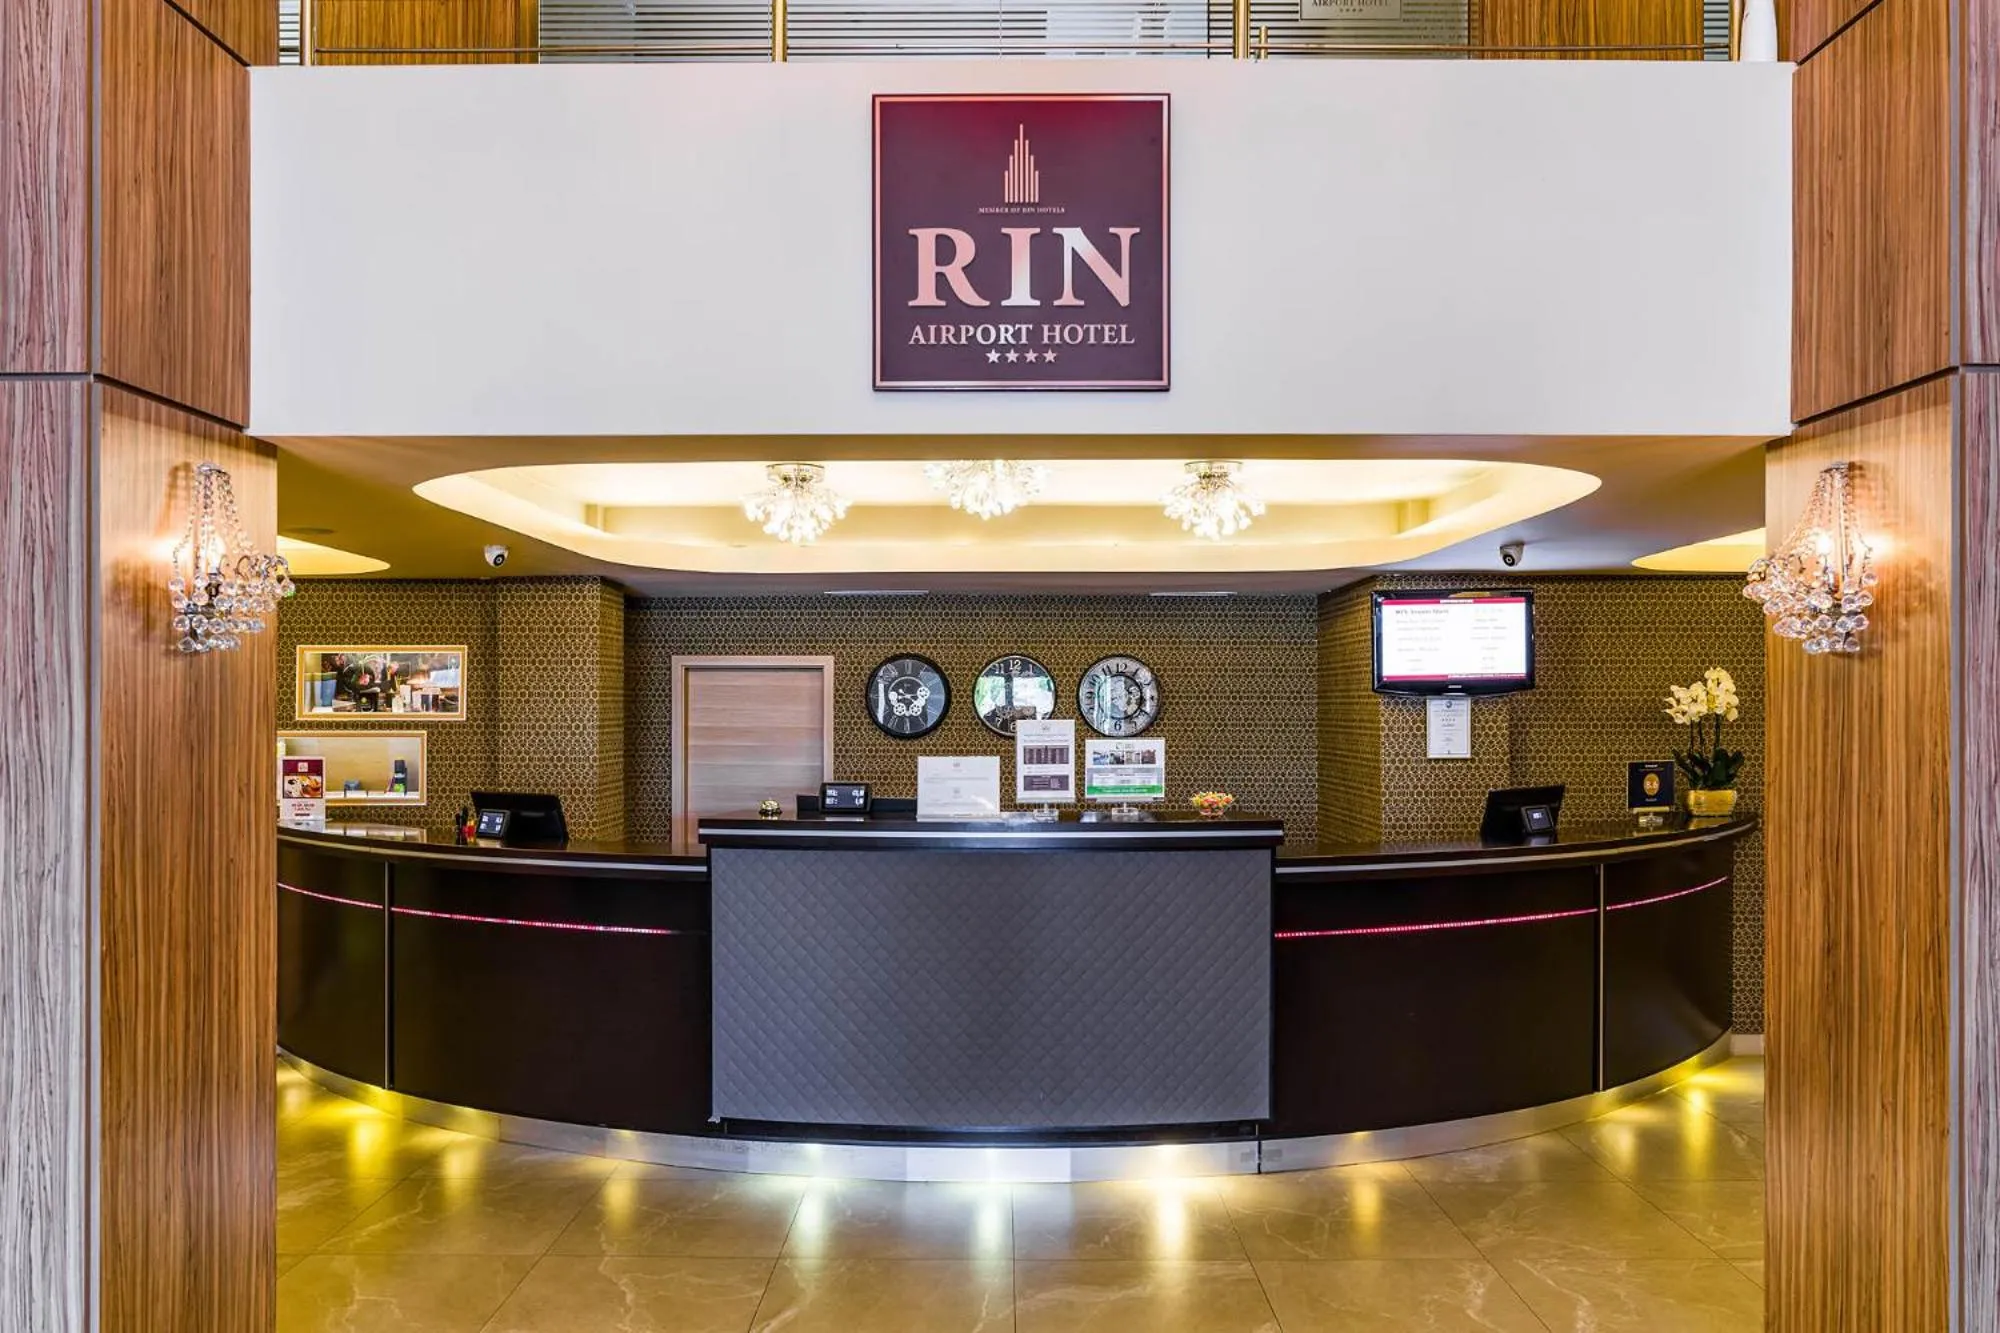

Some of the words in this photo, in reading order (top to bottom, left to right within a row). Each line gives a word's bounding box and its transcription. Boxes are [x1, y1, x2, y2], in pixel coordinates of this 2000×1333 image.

[908, 227, 1141, 307] RIN
[908, 324, 1032, 345] AIRPORT
[1041, 324, 1135, 345] HOTEL
[1009, 659, 1022, 671] 12
[1115, 663, 1128, 674] 12
